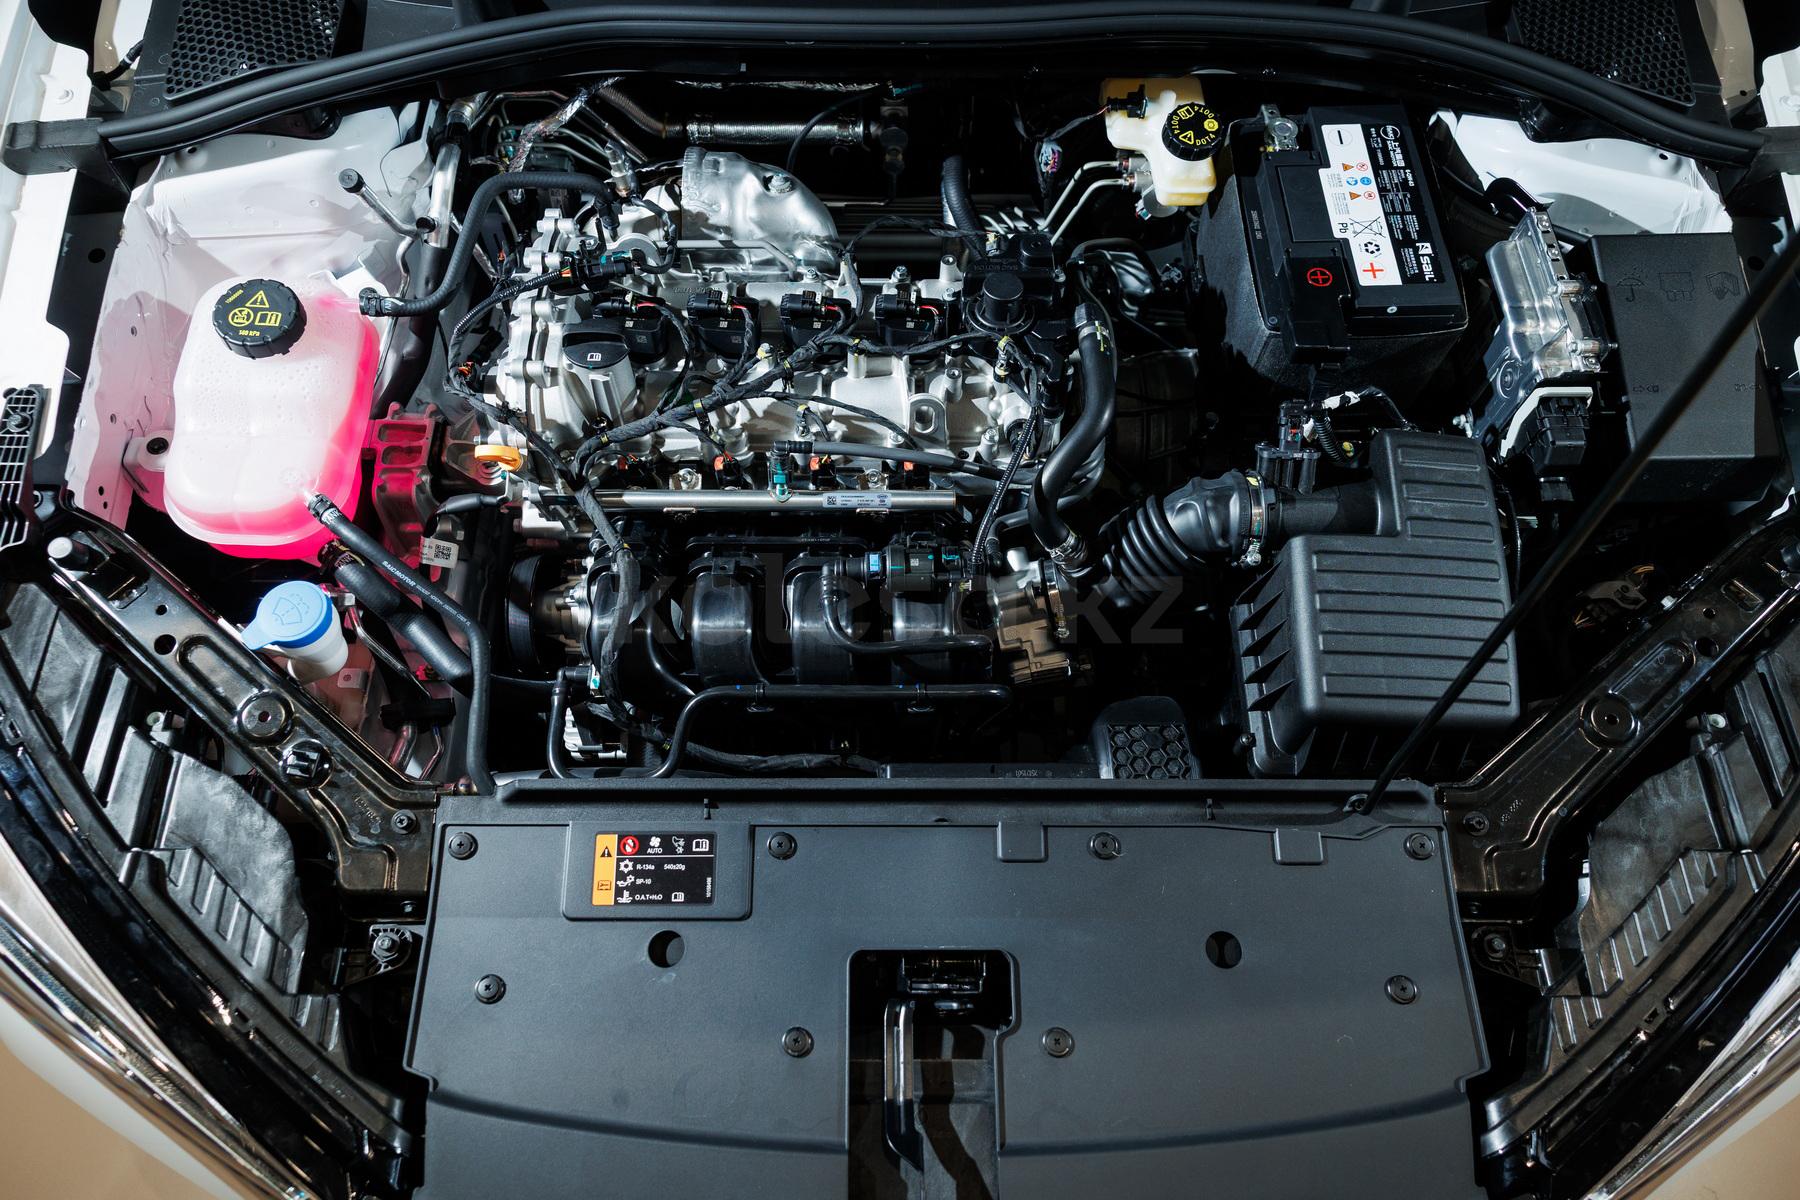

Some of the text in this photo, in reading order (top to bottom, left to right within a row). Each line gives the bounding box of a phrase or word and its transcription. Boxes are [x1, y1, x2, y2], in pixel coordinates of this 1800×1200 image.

[1194, 105, 1215, 119] DOT4
[1171, 115, 1180, 134] DOT4
[1195, 132, 1216, 146] DOT4
[1337, 222, 1349, 234] Pb
